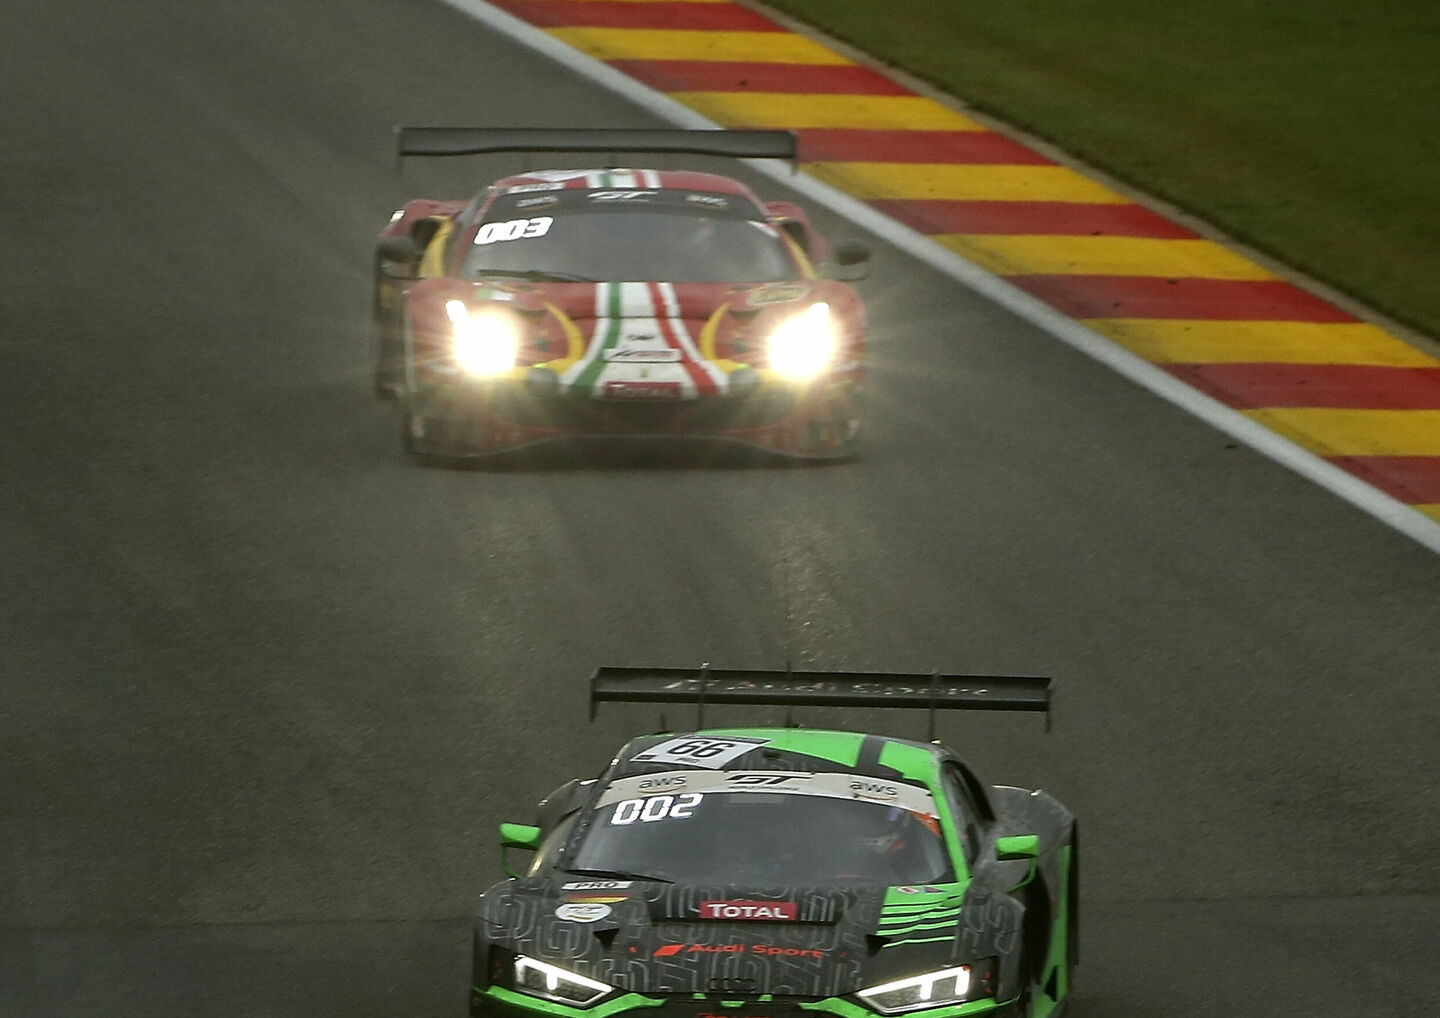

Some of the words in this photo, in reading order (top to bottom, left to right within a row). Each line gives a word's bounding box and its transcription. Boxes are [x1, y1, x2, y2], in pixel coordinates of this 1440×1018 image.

[473, 217, 553, 245] 003
[667, 740, 738, 758] 66
[639, 773, 687, 790] aws
[850, 778, 898, 796] aws
[611, 793, 704, 825] 002
[575, 880, 618, 889] PRO
[708, 903, 789, 919] TOTAL
[687, 943, 745, 953] Audi
[751, 944, 823, 958] Sport
